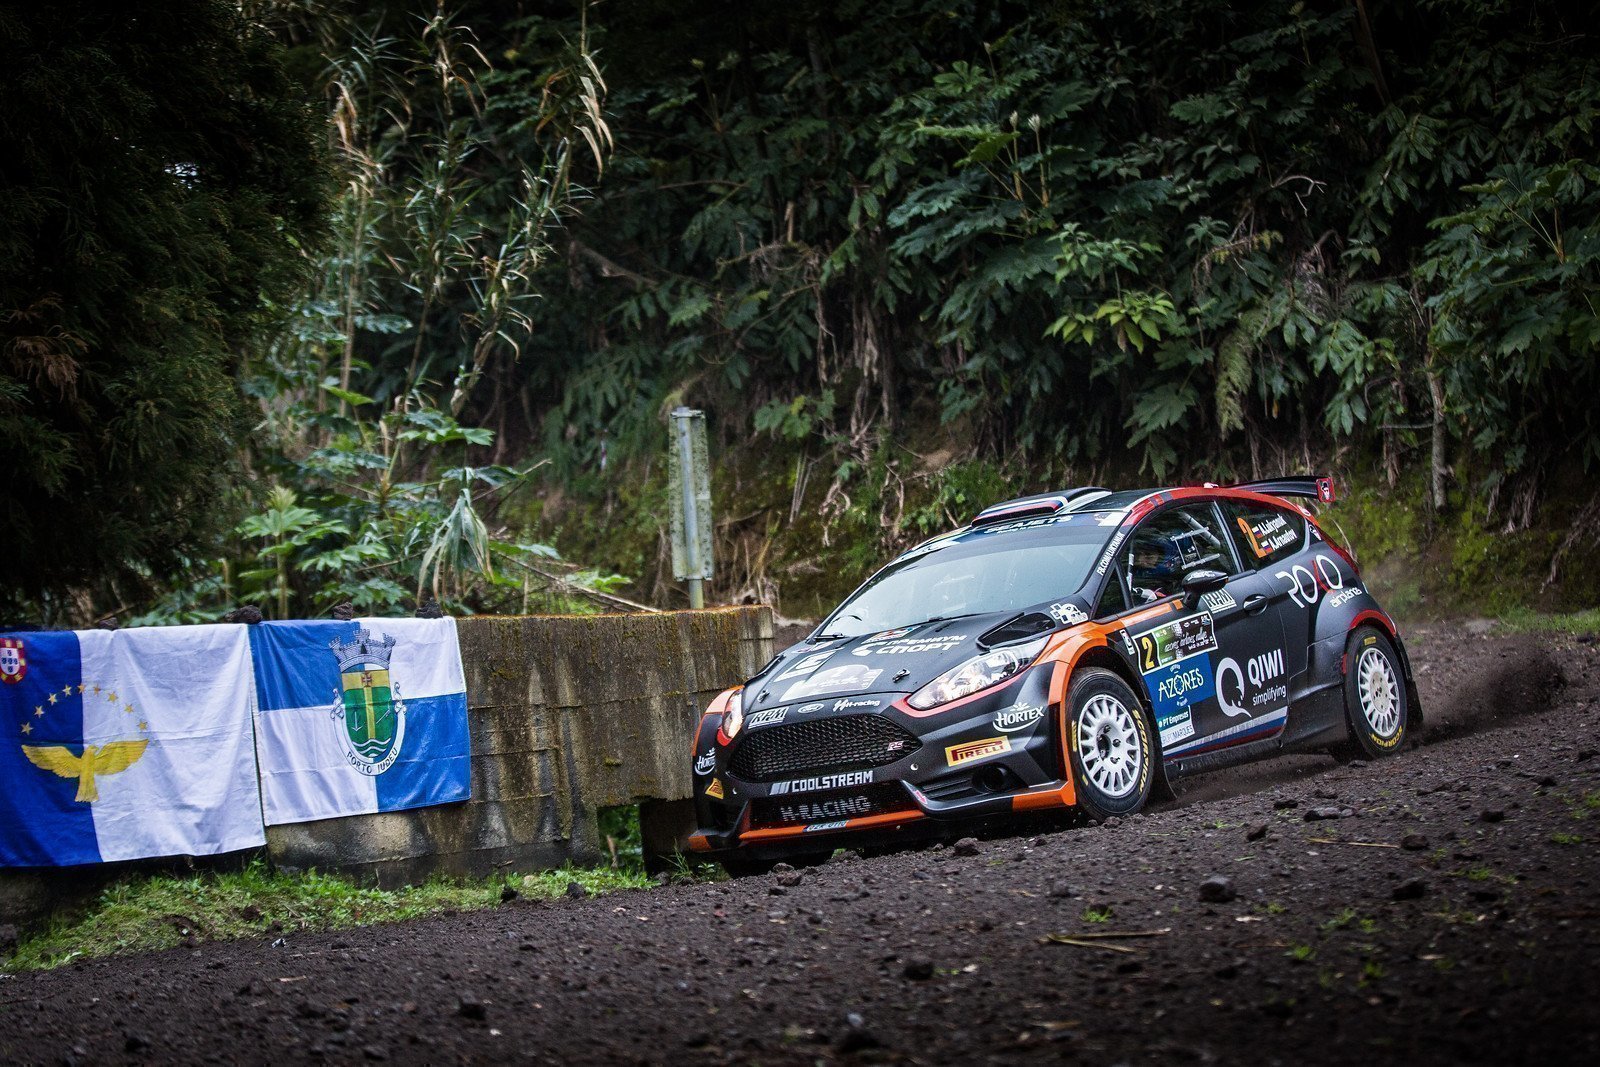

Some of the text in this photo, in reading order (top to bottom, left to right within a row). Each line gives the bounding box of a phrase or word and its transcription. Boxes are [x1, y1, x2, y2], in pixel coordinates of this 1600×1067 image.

[1237, 517, 1267, 558] 2
[875, 642, 961, 654] СПОРТ
[1141, 636, 1155, 670] 2
[1247, 648, 1285, 689] QIWI
[1158, 668, 1204, 702] AZORES
[1252, 685, 1287, 706] simplifying
[751, 707, 787, 725] RPM
[995, 706, 1045, 728] HORTEX
[346, 751, 373, 774] PORTO
[951, 740, 1004, 762] PIRELLI
[791, 770, 874, 793] COOLSTREAM
[780, 795, 871, 821] H-RACING
